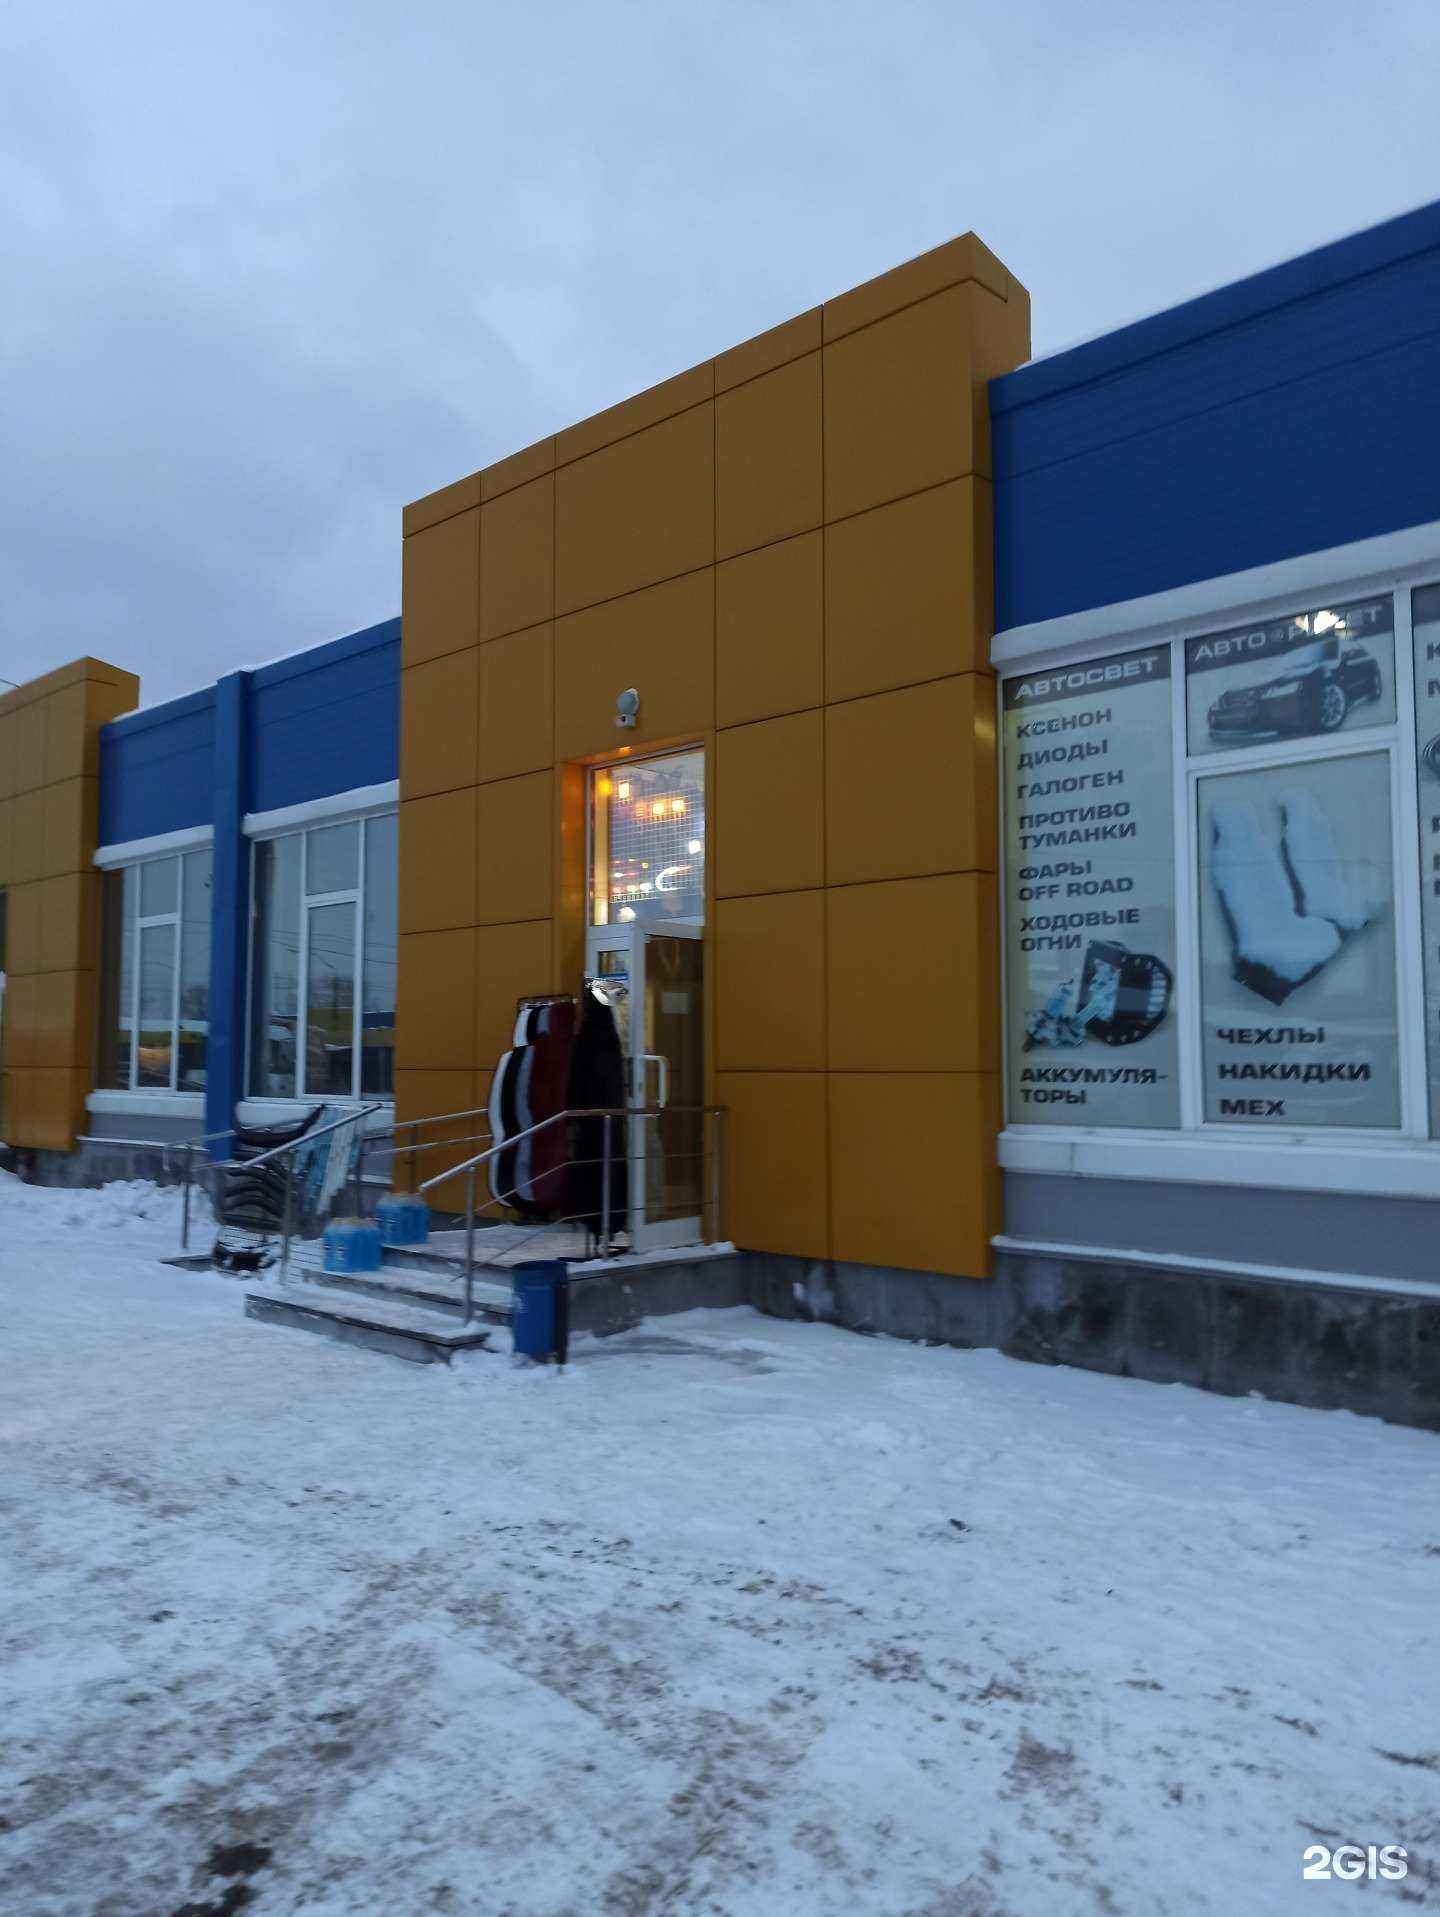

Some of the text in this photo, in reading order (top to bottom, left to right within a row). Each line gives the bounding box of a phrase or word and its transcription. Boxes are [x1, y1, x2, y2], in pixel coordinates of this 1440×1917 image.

[1194, 632, 1266, 662] АВТО
[1014, 656, 1159, 700] АВТОСВЕТ
[1016, 708, 1112, 738] КСЕНОН
[1017, 739, 1109, 770] ДИОДЫ
[1017, 769, 1124, 799] ГАЛОГЕН
[1019, 802, 1130, 829] ПРОТИВО
[1019, 822, 1137, 850] ТУМАНКИ
[1018, 860, 1092, 880] ФАРЫ
[1018, 877, 1134, 901] OFF ROAD
[1020, 908, 1141, 932] ХОДОВЫЕ
[1020, 934, 1082, 952] ОГНИ
[1217, 1027, 1325, 1044] ЧЕХЛЫ
[1020, 1067, 1169, 1084] АККУМУЛЯ-
[1218, 1063, 1372, 1084] НАКИДКИ
[1020, 1089, 1088, 1105] ТОРЫ
[1220, 1099, 1287, 1117] МЕХ
